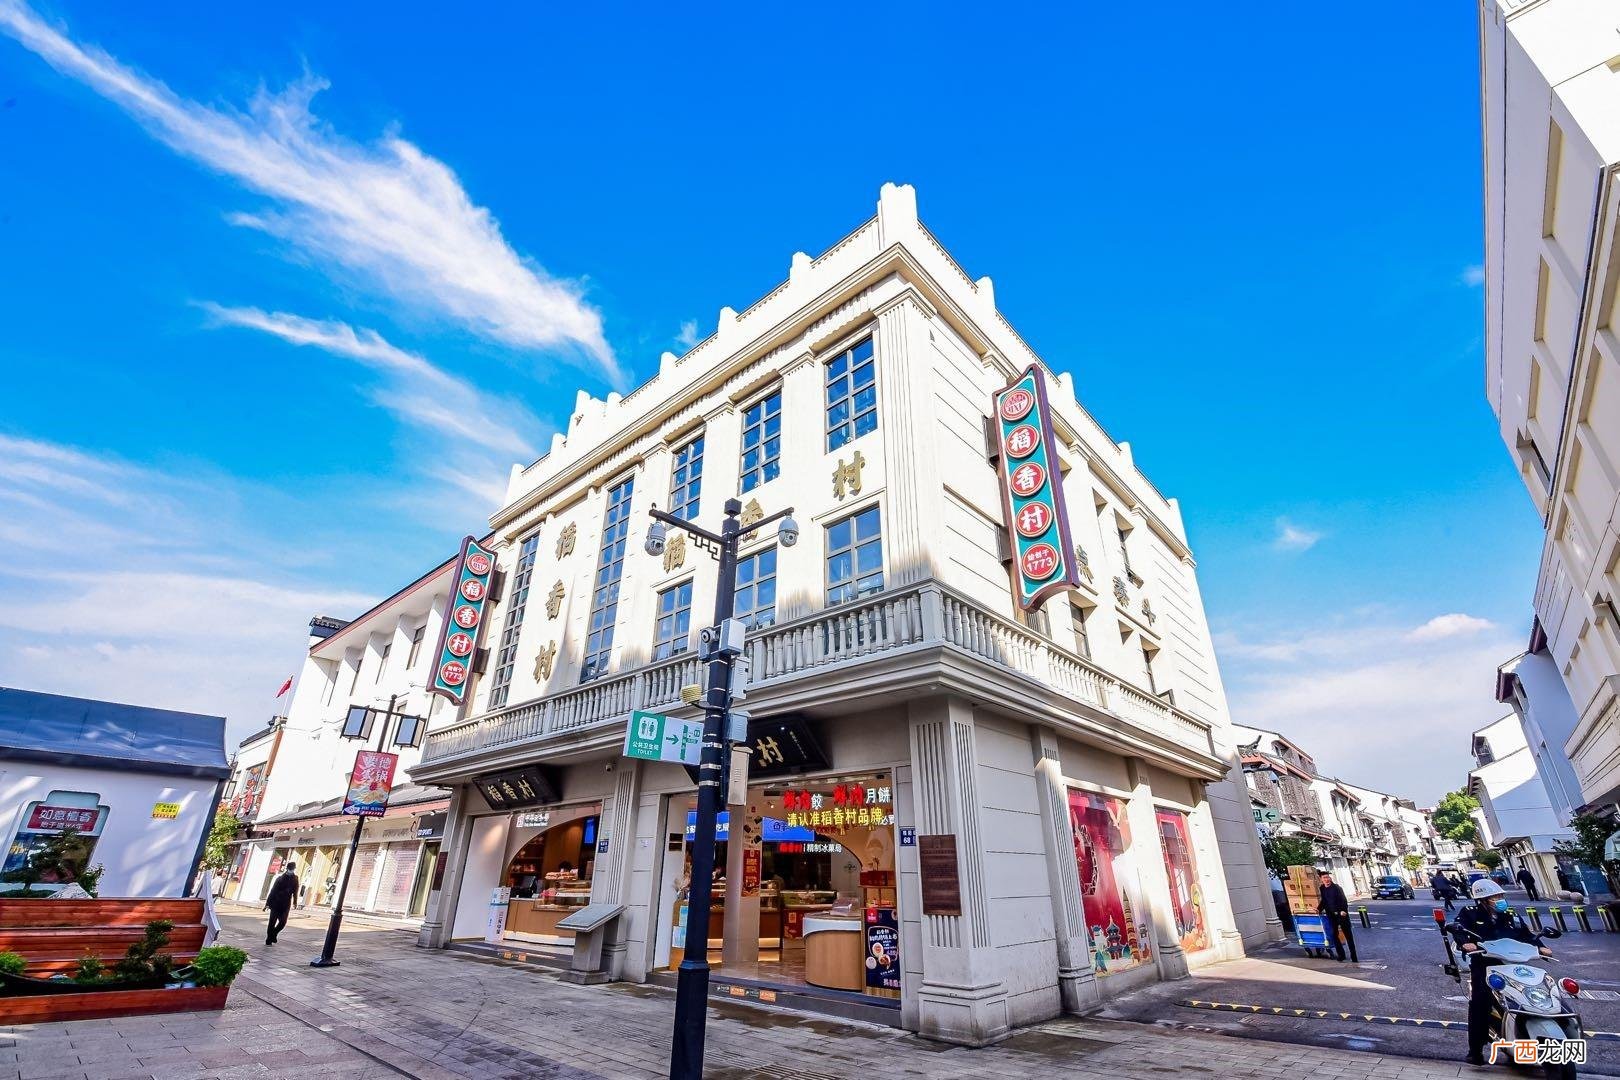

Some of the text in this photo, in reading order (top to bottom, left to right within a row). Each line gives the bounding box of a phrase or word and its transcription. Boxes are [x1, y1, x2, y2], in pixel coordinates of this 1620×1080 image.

[1011, 429, 1043, 532] 稻香村
[1027, 557, 1053, 571] 1773
[533, 521, 576, 683] 稻香村
[453, 582, 480, 652] 稻香村
[445, 671, 462, 680] 1773
[487, 779, 536, 802] 稻香村
[39, 809, 92, 822] 如意檀香
[787, 807, 883, 827] 请认准稻香村品牌
